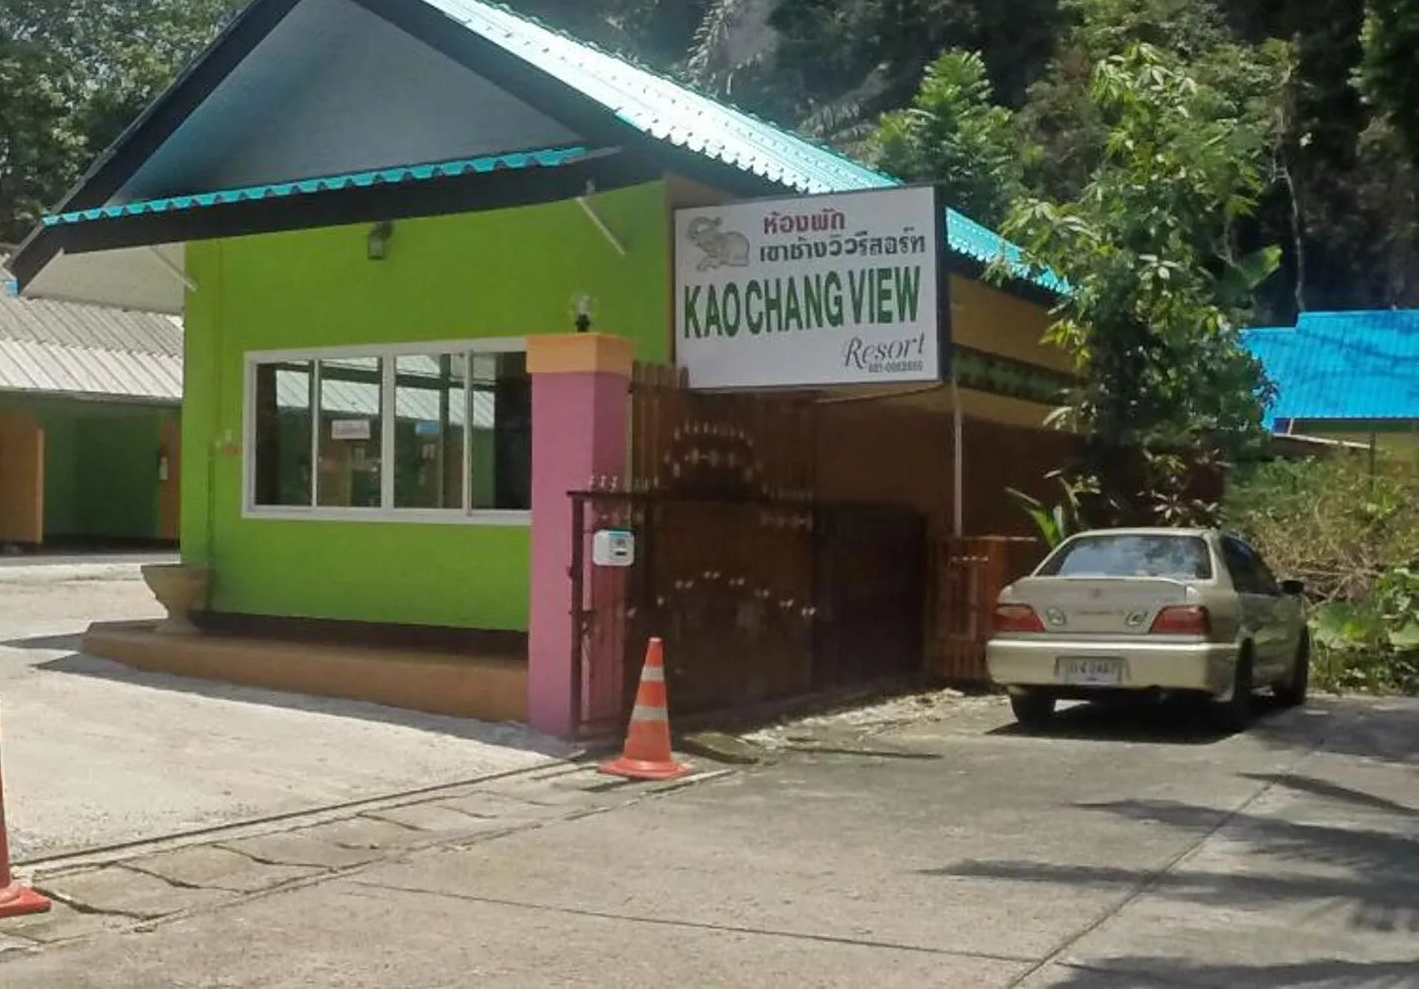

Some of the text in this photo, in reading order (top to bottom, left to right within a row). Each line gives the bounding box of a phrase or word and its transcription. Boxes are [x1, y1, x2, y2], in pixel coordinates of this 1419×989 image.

[763, 208, 845, 234] ห้องพัก
[848, 266, 921, 324] VIEW
[844, 332, 925, 370] Resort
